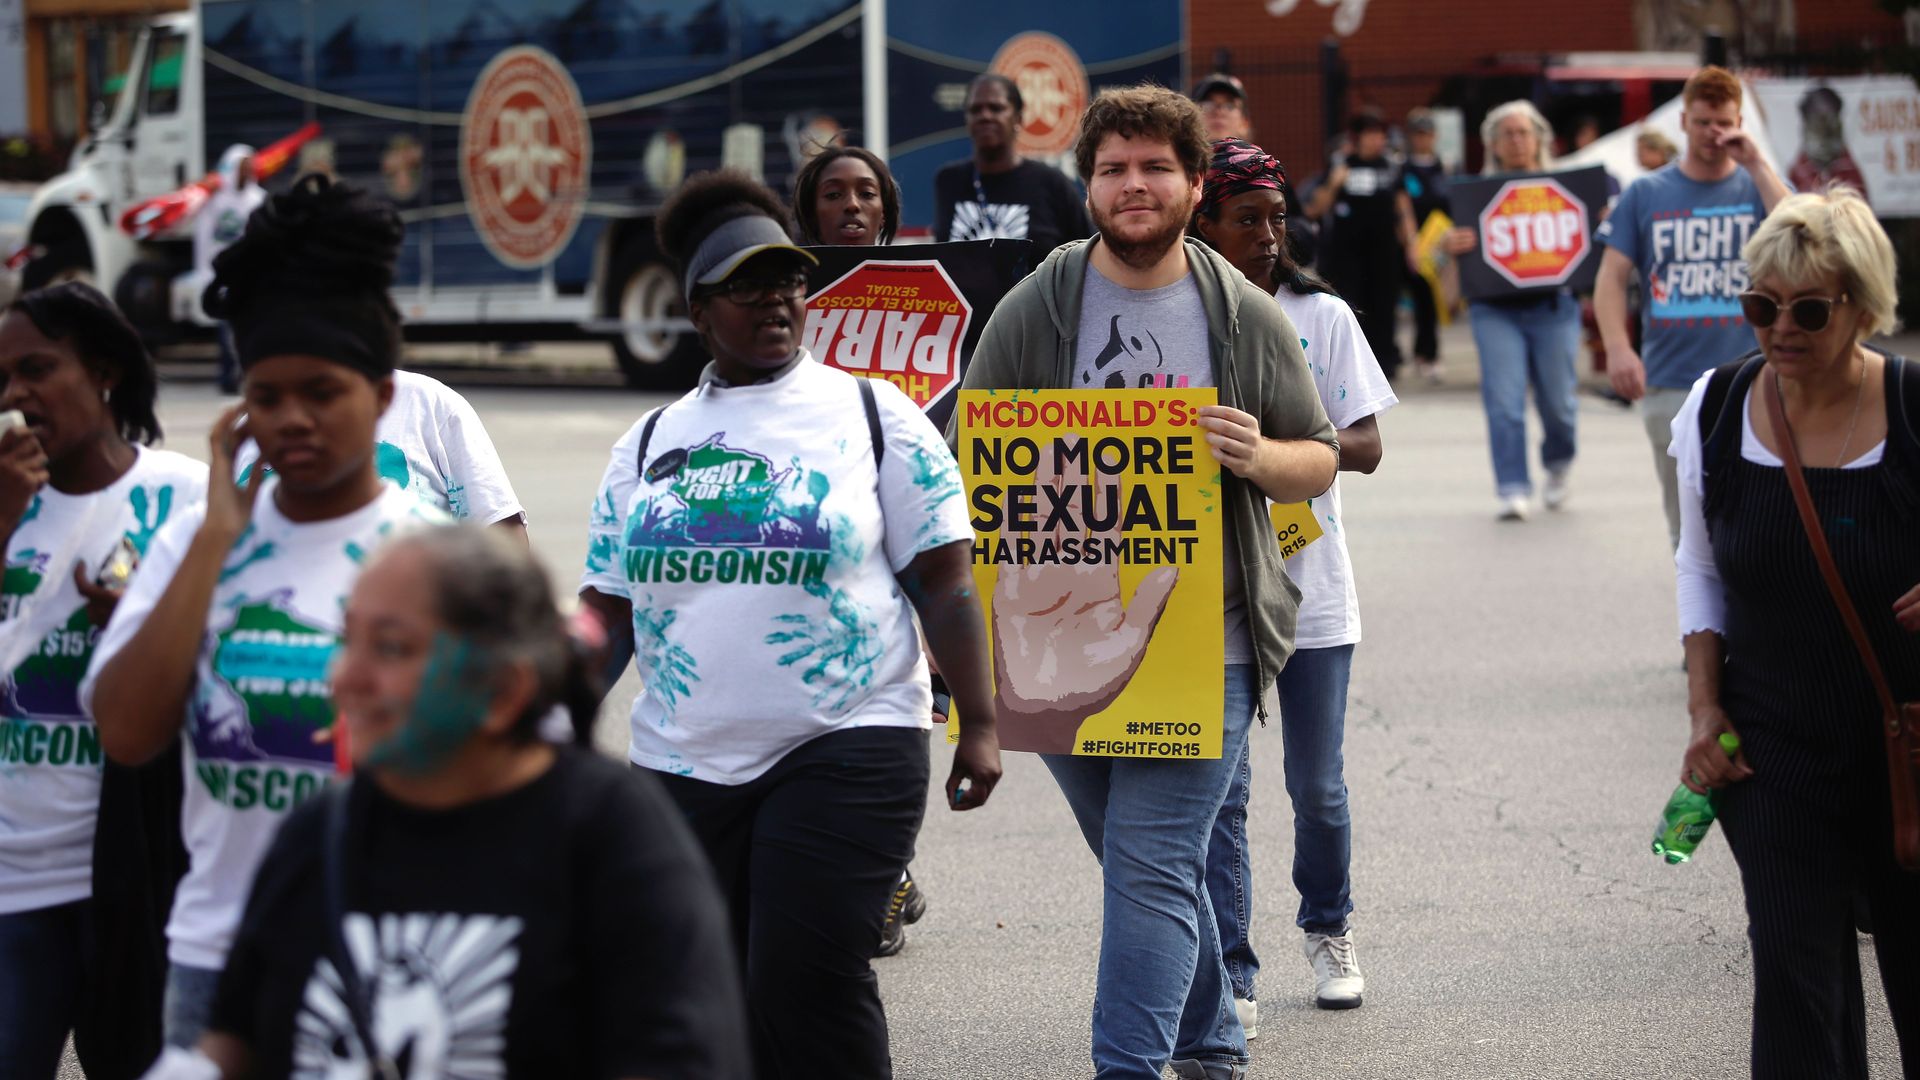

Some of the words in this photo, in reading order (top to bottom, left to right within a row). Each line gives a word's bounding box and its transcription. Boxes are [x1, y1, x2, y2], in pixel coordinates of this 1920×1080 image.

[1490, 211, 1579, 257] STOP
[1652, 214, 1755, 262] FIGHT
[816, 296, 878, 309] ACOSO
[865, 284, 920, 298] SEXUAL
[882, 297, 899, 310] EL
[902, 299, 960, 313] PARAR
[803, 309, 961, 375] PARA
[967, 400, 1198, 428] MCDONALD'S:
[972, 437, 1040, 476] NO
[1053, 436, 1194, 476] MORE
[684, 484, 720, 500] FOR
[970, 483, 1197, 532] SEXUAL
[972, 537, 1199, 565] HARASSMENT
[626, 549, 830, 585] WISCONSIN
[1126, 722, 1201, 736] #METOO
[1082, 740, 1200, 756] #FIGHTFOR15
